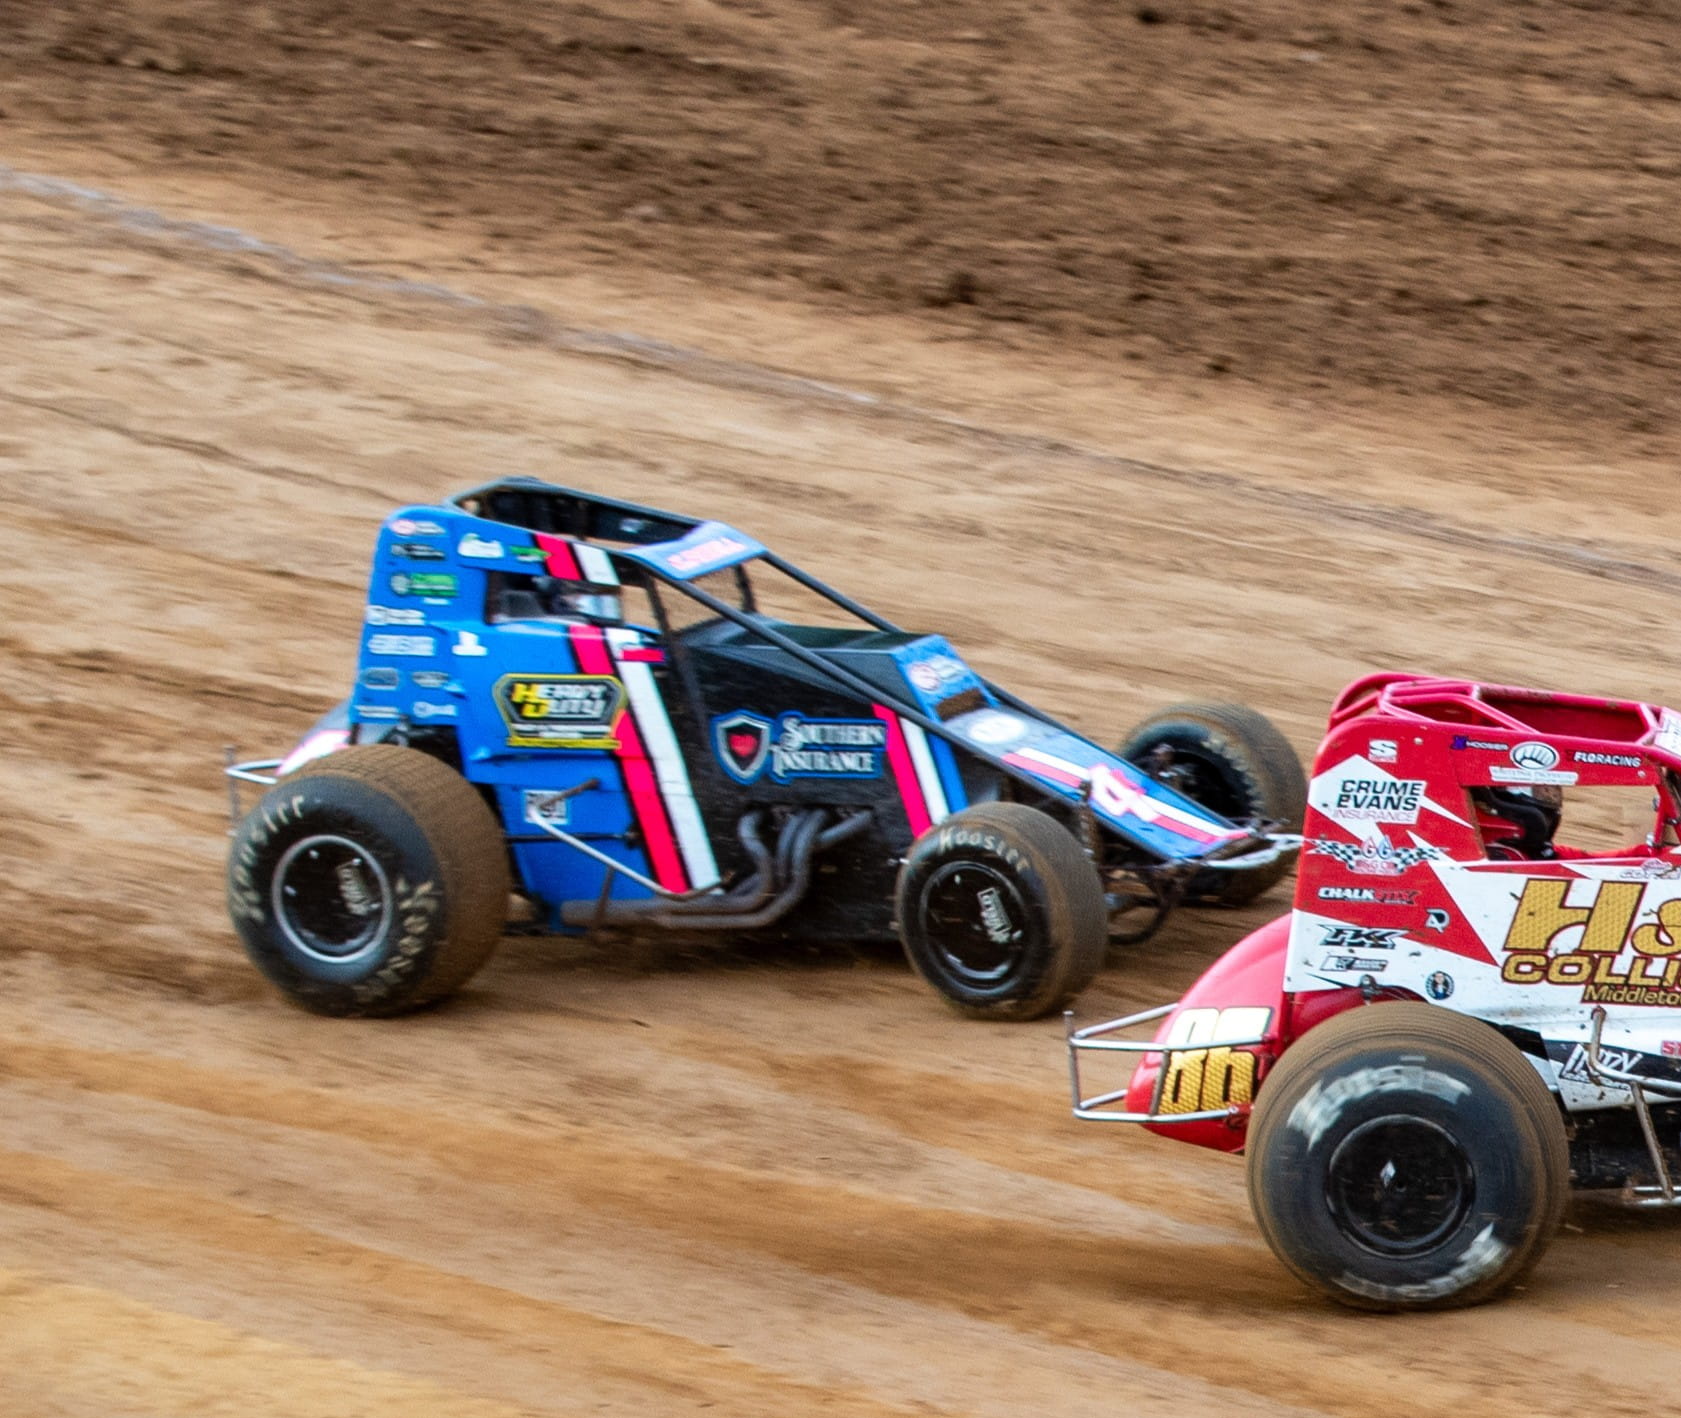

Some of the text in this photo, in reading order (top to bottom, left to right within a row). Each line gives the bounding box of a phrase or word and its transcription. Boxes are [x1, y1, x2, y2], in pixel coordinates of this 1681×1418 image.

[1573, 751, 1642, 767] FLORACING
[1341, 779, 1422, 796] CRUME
[1336, 794, 1418, 811] EVANS
[1334, 809, 1415, 822] INSURANCE
